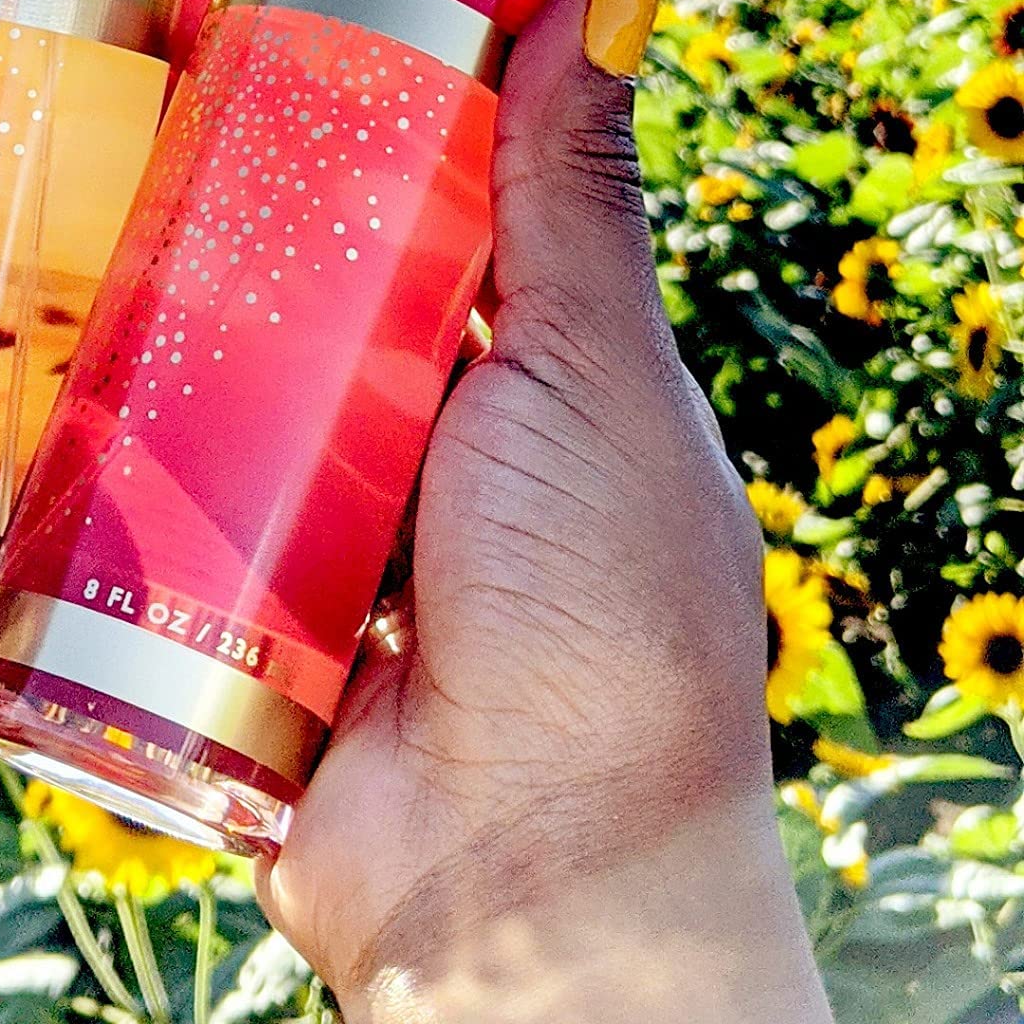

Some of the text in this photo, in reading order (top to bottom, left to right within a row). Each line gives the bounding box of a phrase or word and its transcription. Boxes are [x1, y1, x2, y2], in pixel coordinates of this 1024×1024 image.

[83, 578, 100, 600] 8
[106, 585, 135, 615] FL
[146, 602, 191, 636] OZ
[195, 623, 212, 643] /
[216, 631, 261, 667] 236
